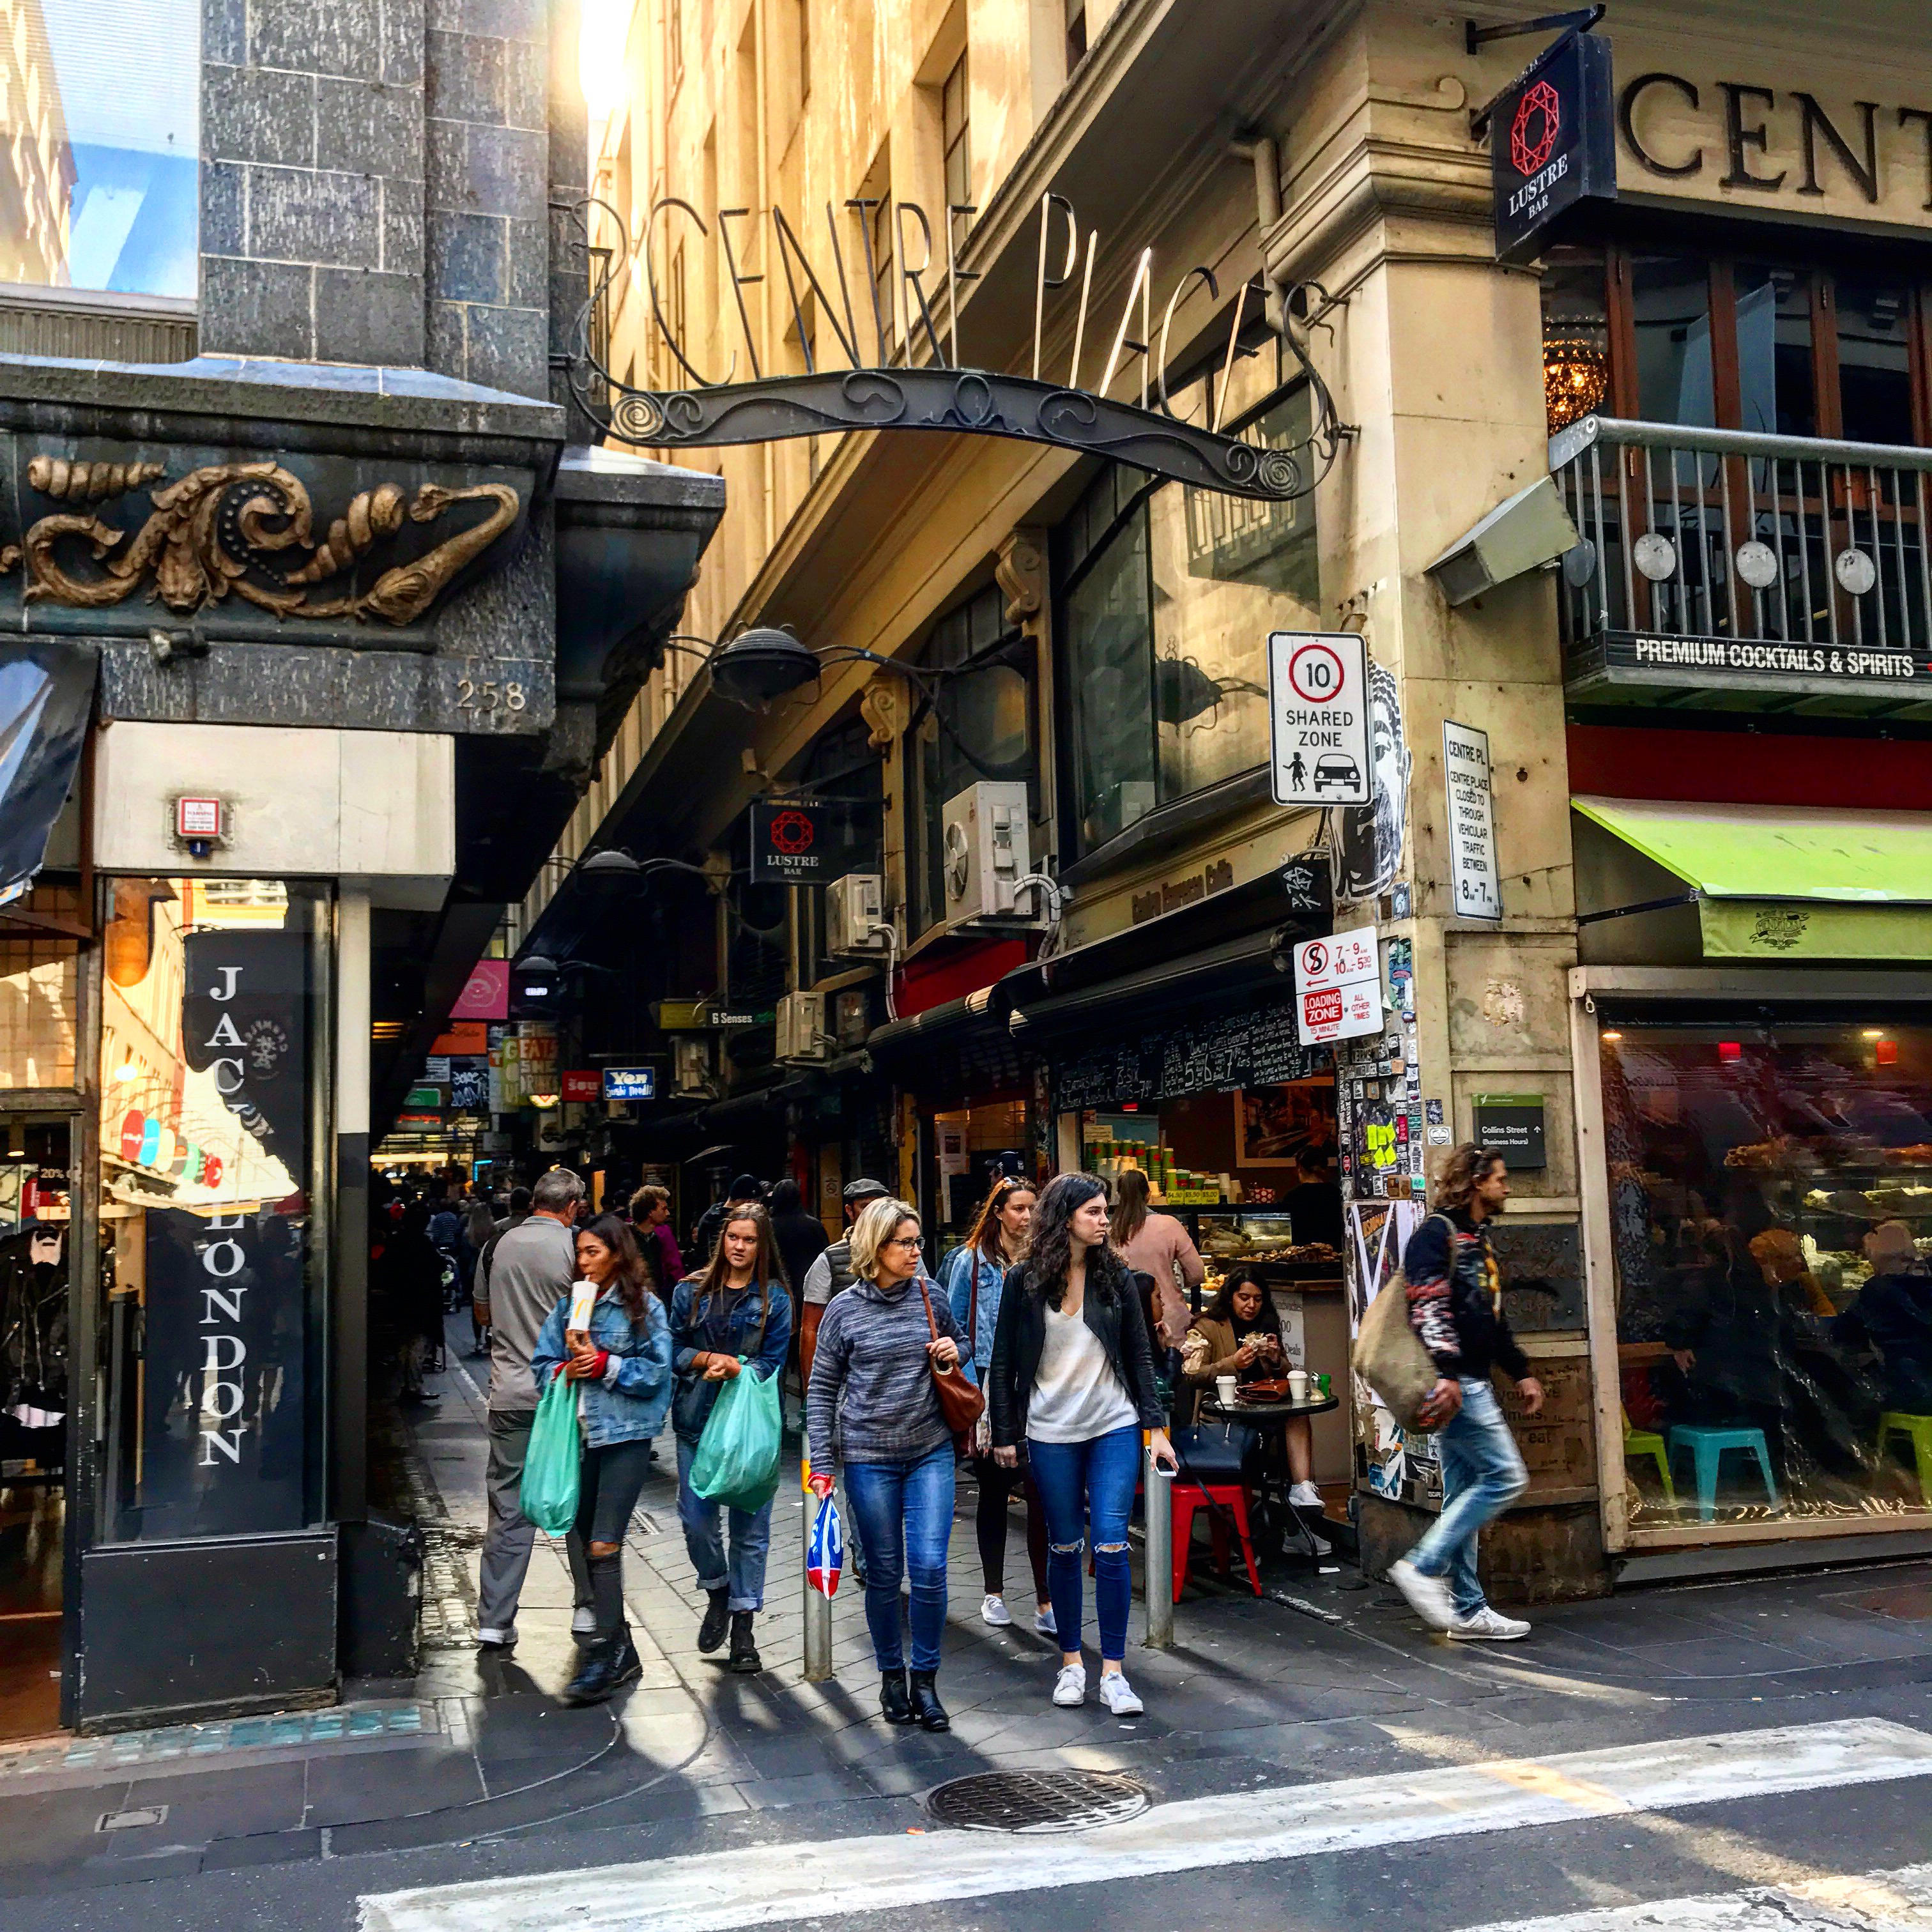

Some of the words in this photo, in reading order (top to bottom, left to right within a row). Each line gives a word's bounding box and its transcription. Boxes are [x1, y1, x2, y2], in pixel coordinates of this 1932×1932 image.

[1508, 154, 1569, 218] LUSTRE
[1528, 194, 1549, 220] BAR
[648, 197, 980, 387] CENTRE
[1636, 638, 1724, 665] PREMIUM
[1729, 643, 1825, 673] COCKTAILS
[1830, 651, 1844, 673] &
[1847, 652, 1915, 678] SPIRITS
[1305, 662, 1331, 688] 10
[456, 678, 527, 712] 258
[1285, 709, 1354, 726] SHARED
[1298, 730, 1343, 747] ZONE
[1448, 740, 1475, 762] CENTRE
[1476, 748, 1486, 765] PL
[1450, 770, 1471, 786] CENTRE
[1470, 775, 1489, 791] PLACE
[1456, 788, 1477, 804] CLOSED
[1476, 793, 1485, 806] TO
[1459, 806, 1484, 823] THROUGH
[1457, 822, 1488, 839] VEHICULAR
[1462, 840, 1485, 856] TRAFFIC
[767, 855, 819, 867] LUSTRE
[1462, 857, 1488, 873] BETWEEN
[783, 867, 802, 875] BAR
[1335, 946, 1343, 959] 7
[1305, 992, 1341, 1011] LOADING
[1354, 993, 1365, 1001] ALL
[1307, 1005, 1340, 1023] ZONE
[1351, 1001, 1370, 1012] OTHER
[721, 1012, 753, 1024] Senses
[1353, 1011, 1370, 1021] TIMES
[1318, 1023, 1340, 1033] MINUTE
[204, 966, 248, 1128] JAC
[609, 1071, 648, 1085] Yen
[1482, 1126, 1505, 1134] Collins
[1506, 1126, 1528, 1134] Street
[198, 1202, 248, 1466] LONDON
